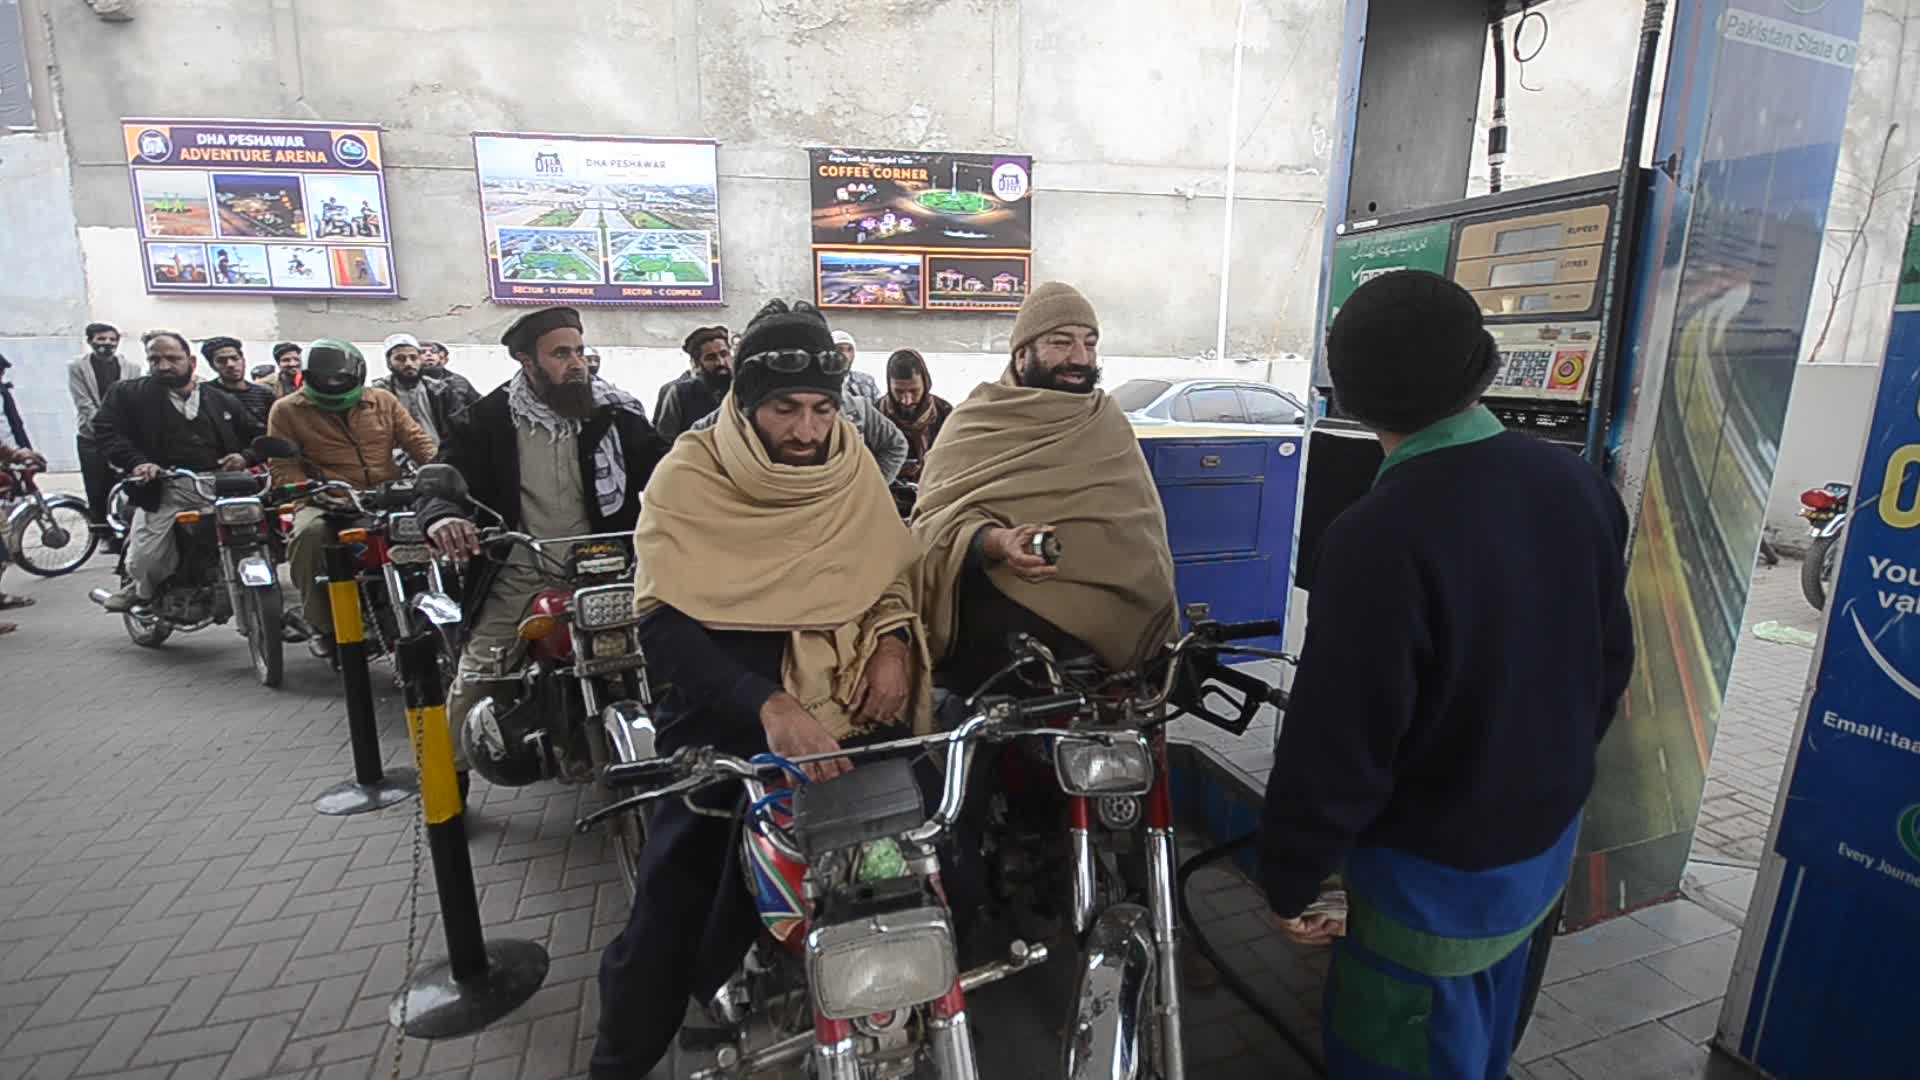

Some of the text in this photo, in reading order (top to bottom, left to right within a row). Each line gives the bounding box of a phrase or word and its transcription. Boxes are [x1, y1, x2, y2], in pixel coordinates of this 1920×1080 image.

[1728, 15, 1793, 48] Pakistan
[1796, 32, 1832, 58] State
[196, 133, 306, 147] DHA PESHAWAR
[180, 148, 328, 163] ADVENTURE ARENA
[585, 158, 667, 169] DHA PESHAWAR
[818, 165, 928, 180] COFFEE CORNER
[512, 285, 544, 294] SECTOR
[557, 286, 595, 296] COMPLEX
[622, 288, 653, 296] SECTOR
[665, 288, 704, 297] COMPLEX
[1838, 842, 1876, 869] Every
